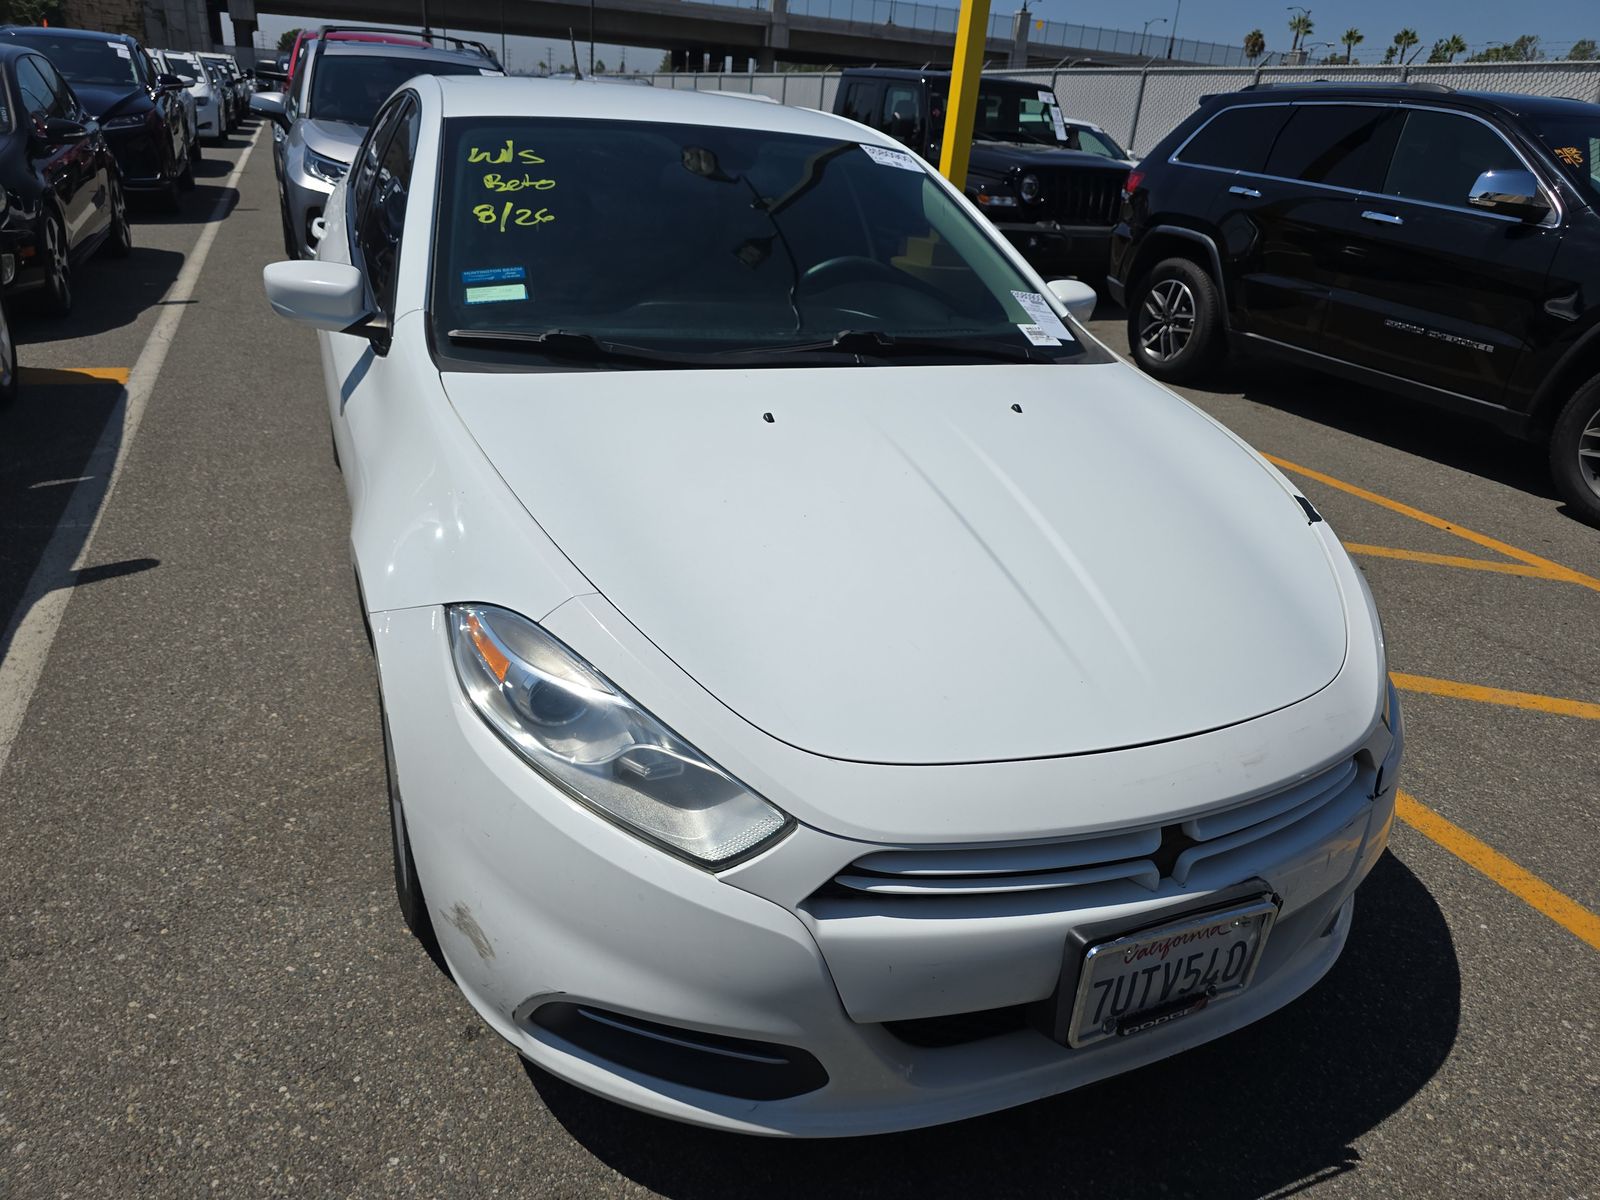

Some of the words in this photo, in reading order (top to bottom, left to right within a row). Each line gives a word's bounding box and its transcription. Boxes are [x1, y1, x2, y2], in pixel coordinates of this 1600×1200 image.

[472, 201, 555, 232] 8/26
[1124, 925, 1233, 964] California
[1093, 940, 1248, 1025] 7UTV540
